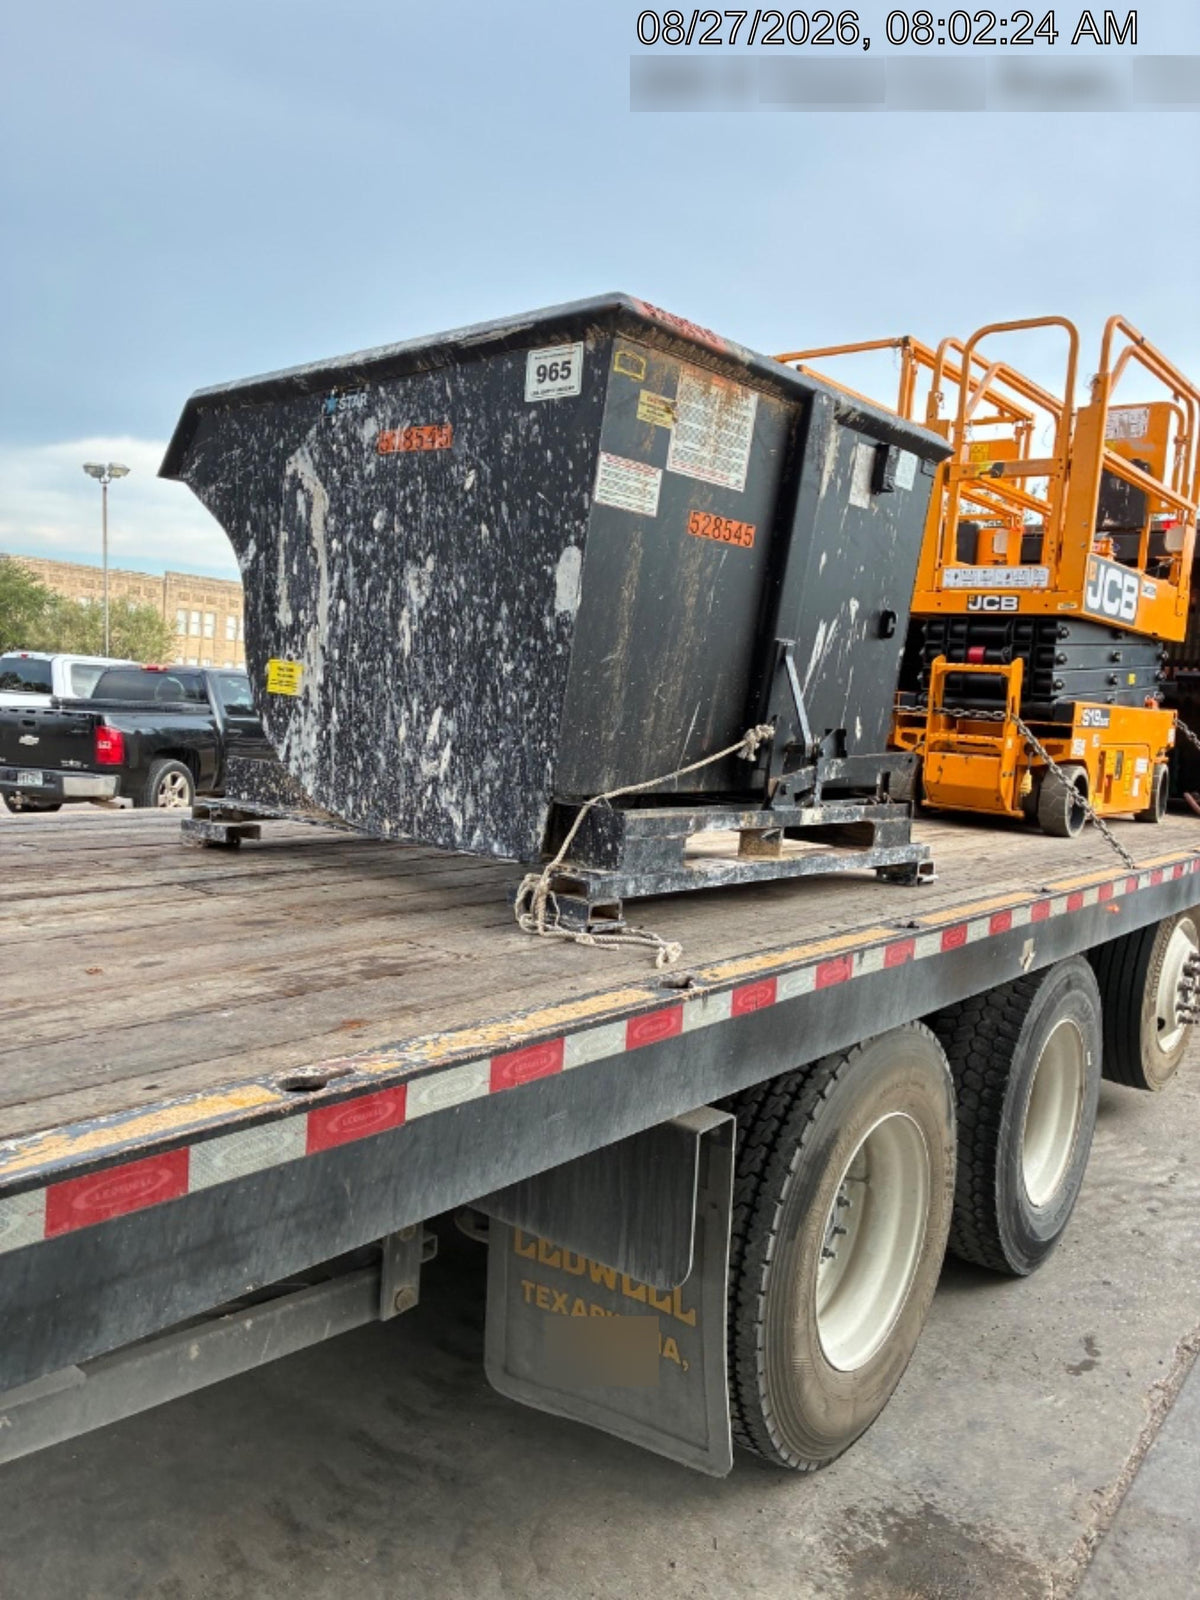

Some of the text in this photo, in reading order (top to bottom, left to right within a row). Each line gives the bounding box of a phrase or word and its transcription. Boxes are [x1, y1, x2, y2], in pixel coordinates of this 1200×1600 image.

[536, 359, 571, 385] 965
[689, 511, 754, 547] 528545
[968, 595, 1018, 611] JCB
[1086, 563, 1139, 621] JCB
